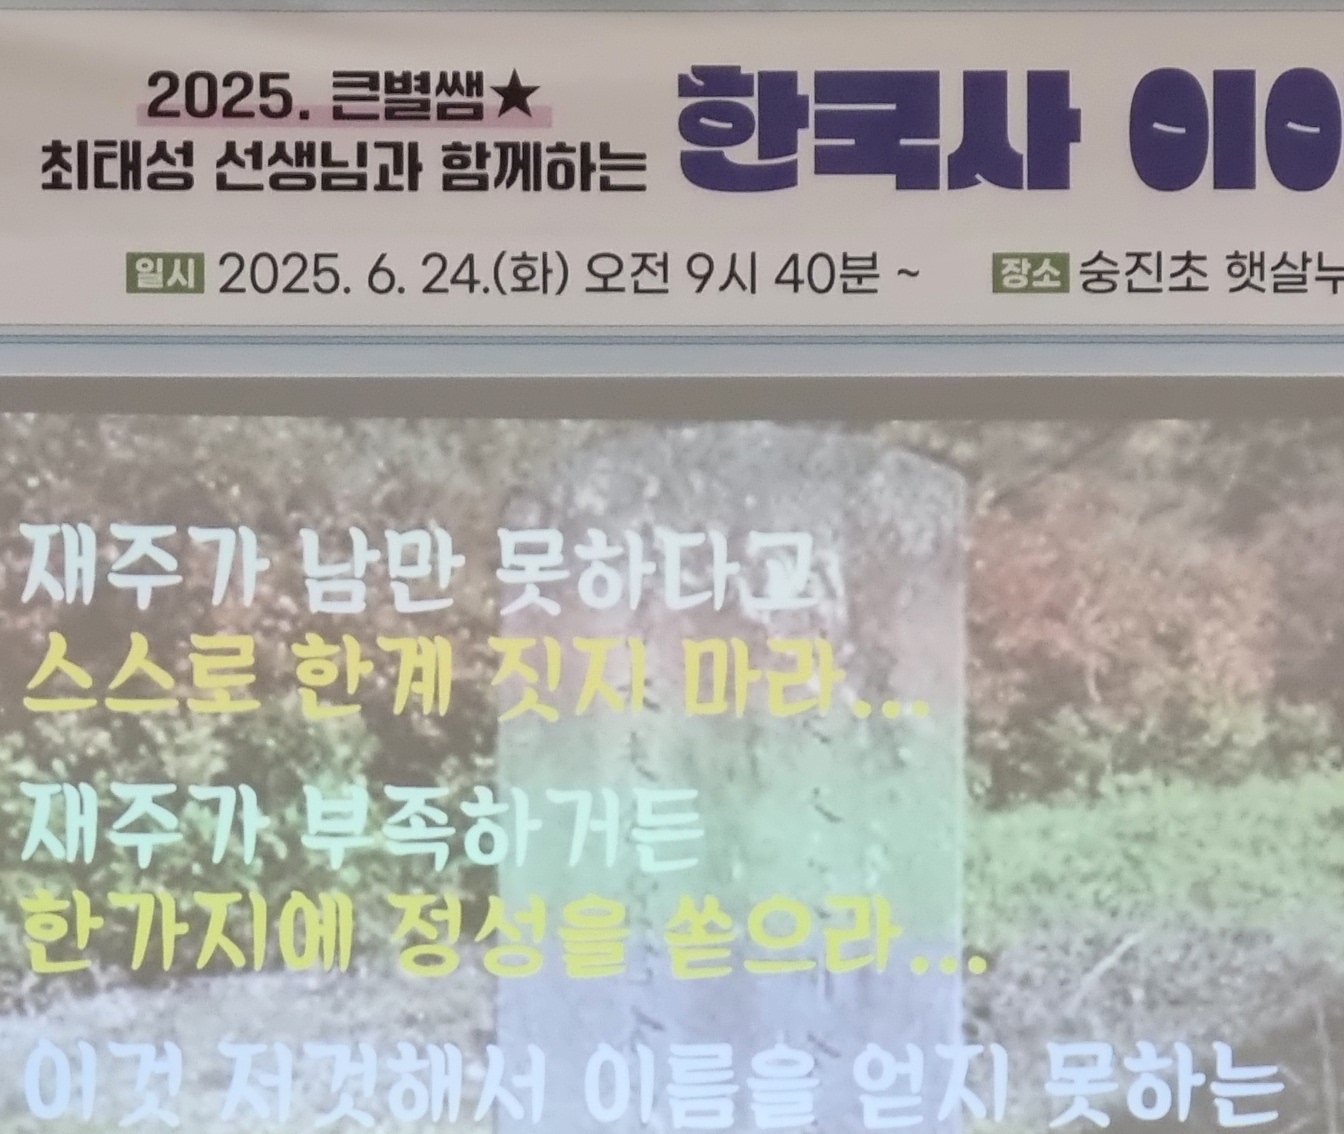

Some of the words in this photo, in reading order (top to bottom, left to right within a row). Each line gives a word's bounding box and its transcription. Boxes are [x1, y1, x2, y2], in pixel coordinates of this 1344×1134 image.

[148, 71, 310, 121] 2025.
[333, 71, 485, 122] 큰별쌤
[677, 65, 1082, 193] 한국사
[42, 140, 195, 191] 최태성
[216, 141, 423, 192] 선생님과
[442, 141, 647, 192] 함께하는
[135, 257, 195, 289] 일시
[219, 252, 351, 295] 2025.
[368, 252, 406, 295] 6.
[422, 251, 569, 296] 24.(화)
[586, 252, 669, 295] 오전
[687, 252, 757, 295] 9시
[775, 252, 880, 295] 40분
[1001, 257, 1061, 289] 장소
[1080, 250, 1210, 294] 숭진초
[19, 523, 271, 610] 재주가
[299, 526, 467, 614] 남만
[495, 527, 816, 616] 못하다고
[23, 632, 261, 714] 스스로
[291, 633, 454, 720] 한계
[487, 635, 646, 722] 짓지
[682, 637, 930, 719] 마라...
[19, 782, 271, 870] 재주가
[300, 783, 705, 873] 부족하거든
[19, 888, 355, 974] 한가지에
[387, 893, 630, 979] 정성을
[664, 894, 987, 980] 쏟으라...
[22, 1039, 183, 1128] 이것
[218, 1040, 547, 1129] 저것해서
[584, 1041, 821, 1130] 이름을
[854, 1042, 1008, 1129] 얻지
[1044, 1040, 1286, 1130] 못하는
